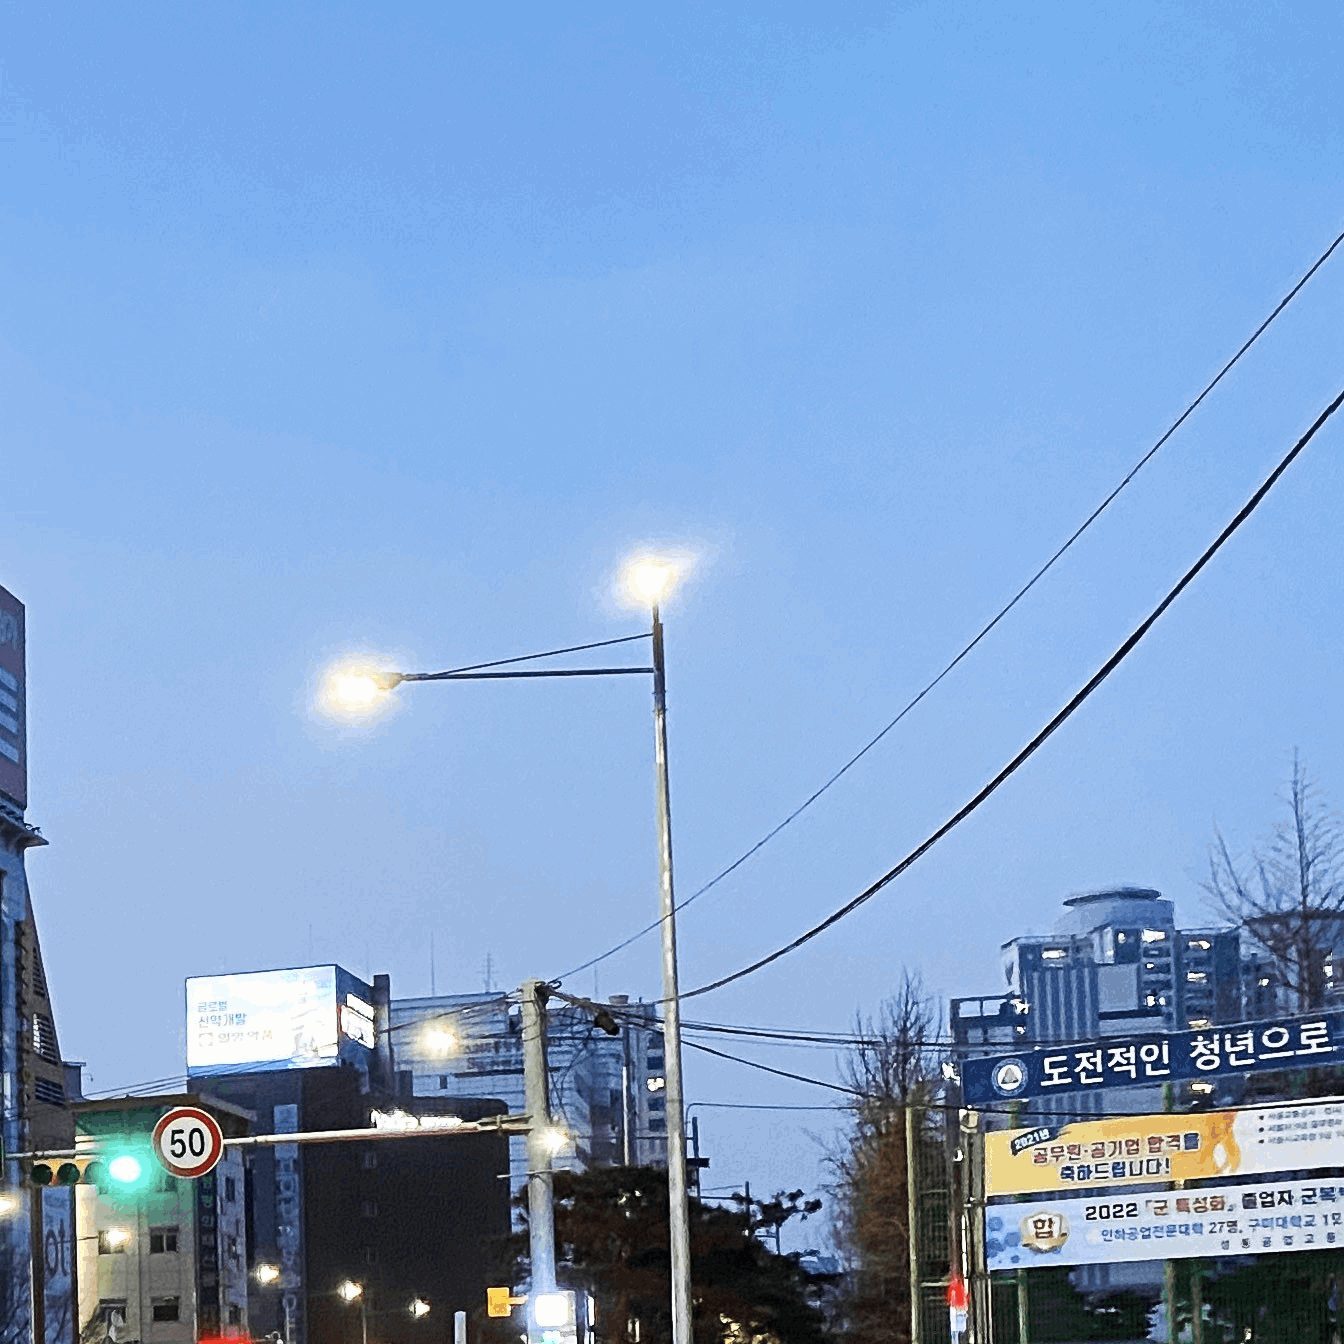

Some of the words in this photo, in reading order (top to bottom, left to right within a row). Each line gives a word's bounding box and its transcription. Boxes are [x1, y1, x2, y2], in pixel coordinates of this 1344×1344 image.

[1041, 1041, 1170, 1087] 도전적인
[1189, 1021, 1335, 1070] 청년으로
[170, 1128, 205, 1158] 50
[1014, 1129, 1050, 1149] 2021년
[1060, 1158, 1170, 1181] 축하드립니다!
[1085, 1202, 1139, 1220] 2022
[1241, 1190, 1294, 1209] 졸업자
[1301, 1186, 1344, 1205] 군복
